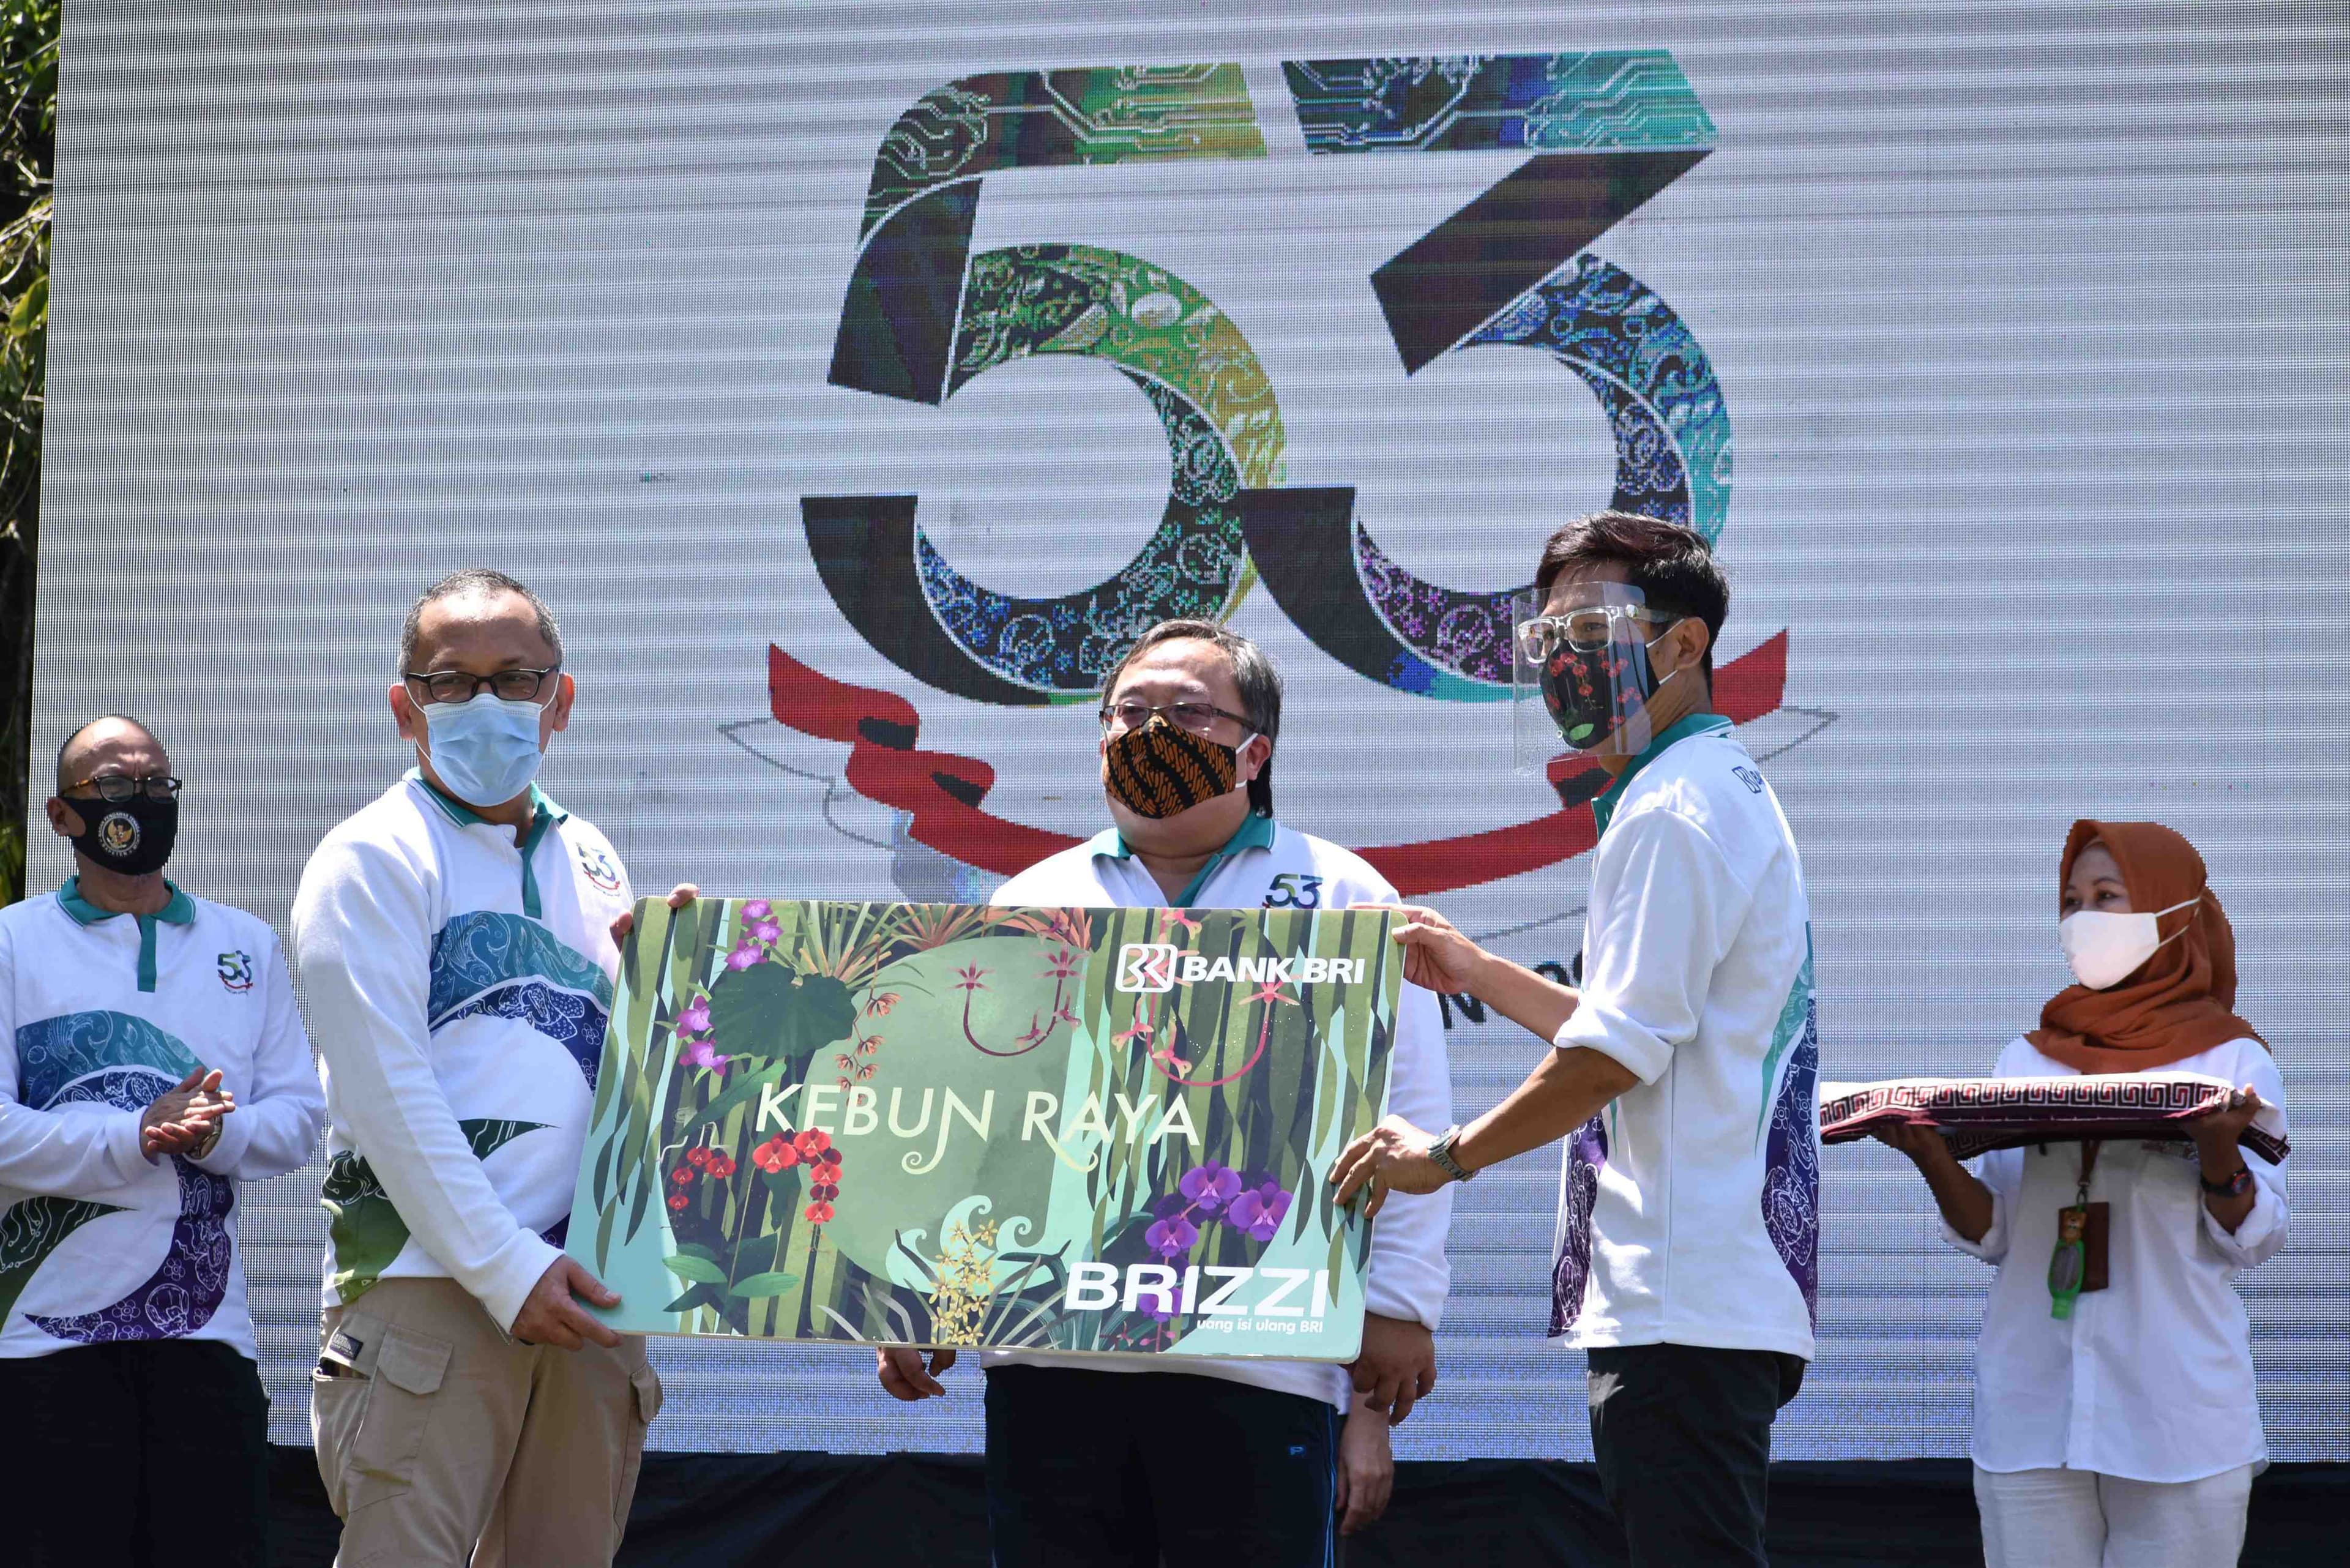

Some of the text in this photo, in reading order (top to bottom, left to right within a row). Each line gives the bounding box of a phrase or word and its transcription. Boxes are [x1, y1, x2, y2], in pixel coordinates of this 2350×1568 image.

[800, 50, 1733, 705] 53
[1265, 873, 1323, 909] 53
[1182, 957, 1296, 984] BANK
[1302, 958, 1365, 984] BRI
[755, 1083, 1200, 1174] KEBUN RAYA
[1064, 1262, 1330, 1318] BRIZZI
[1196, 1318, 1323, 1335] uang isi ulang BRI
